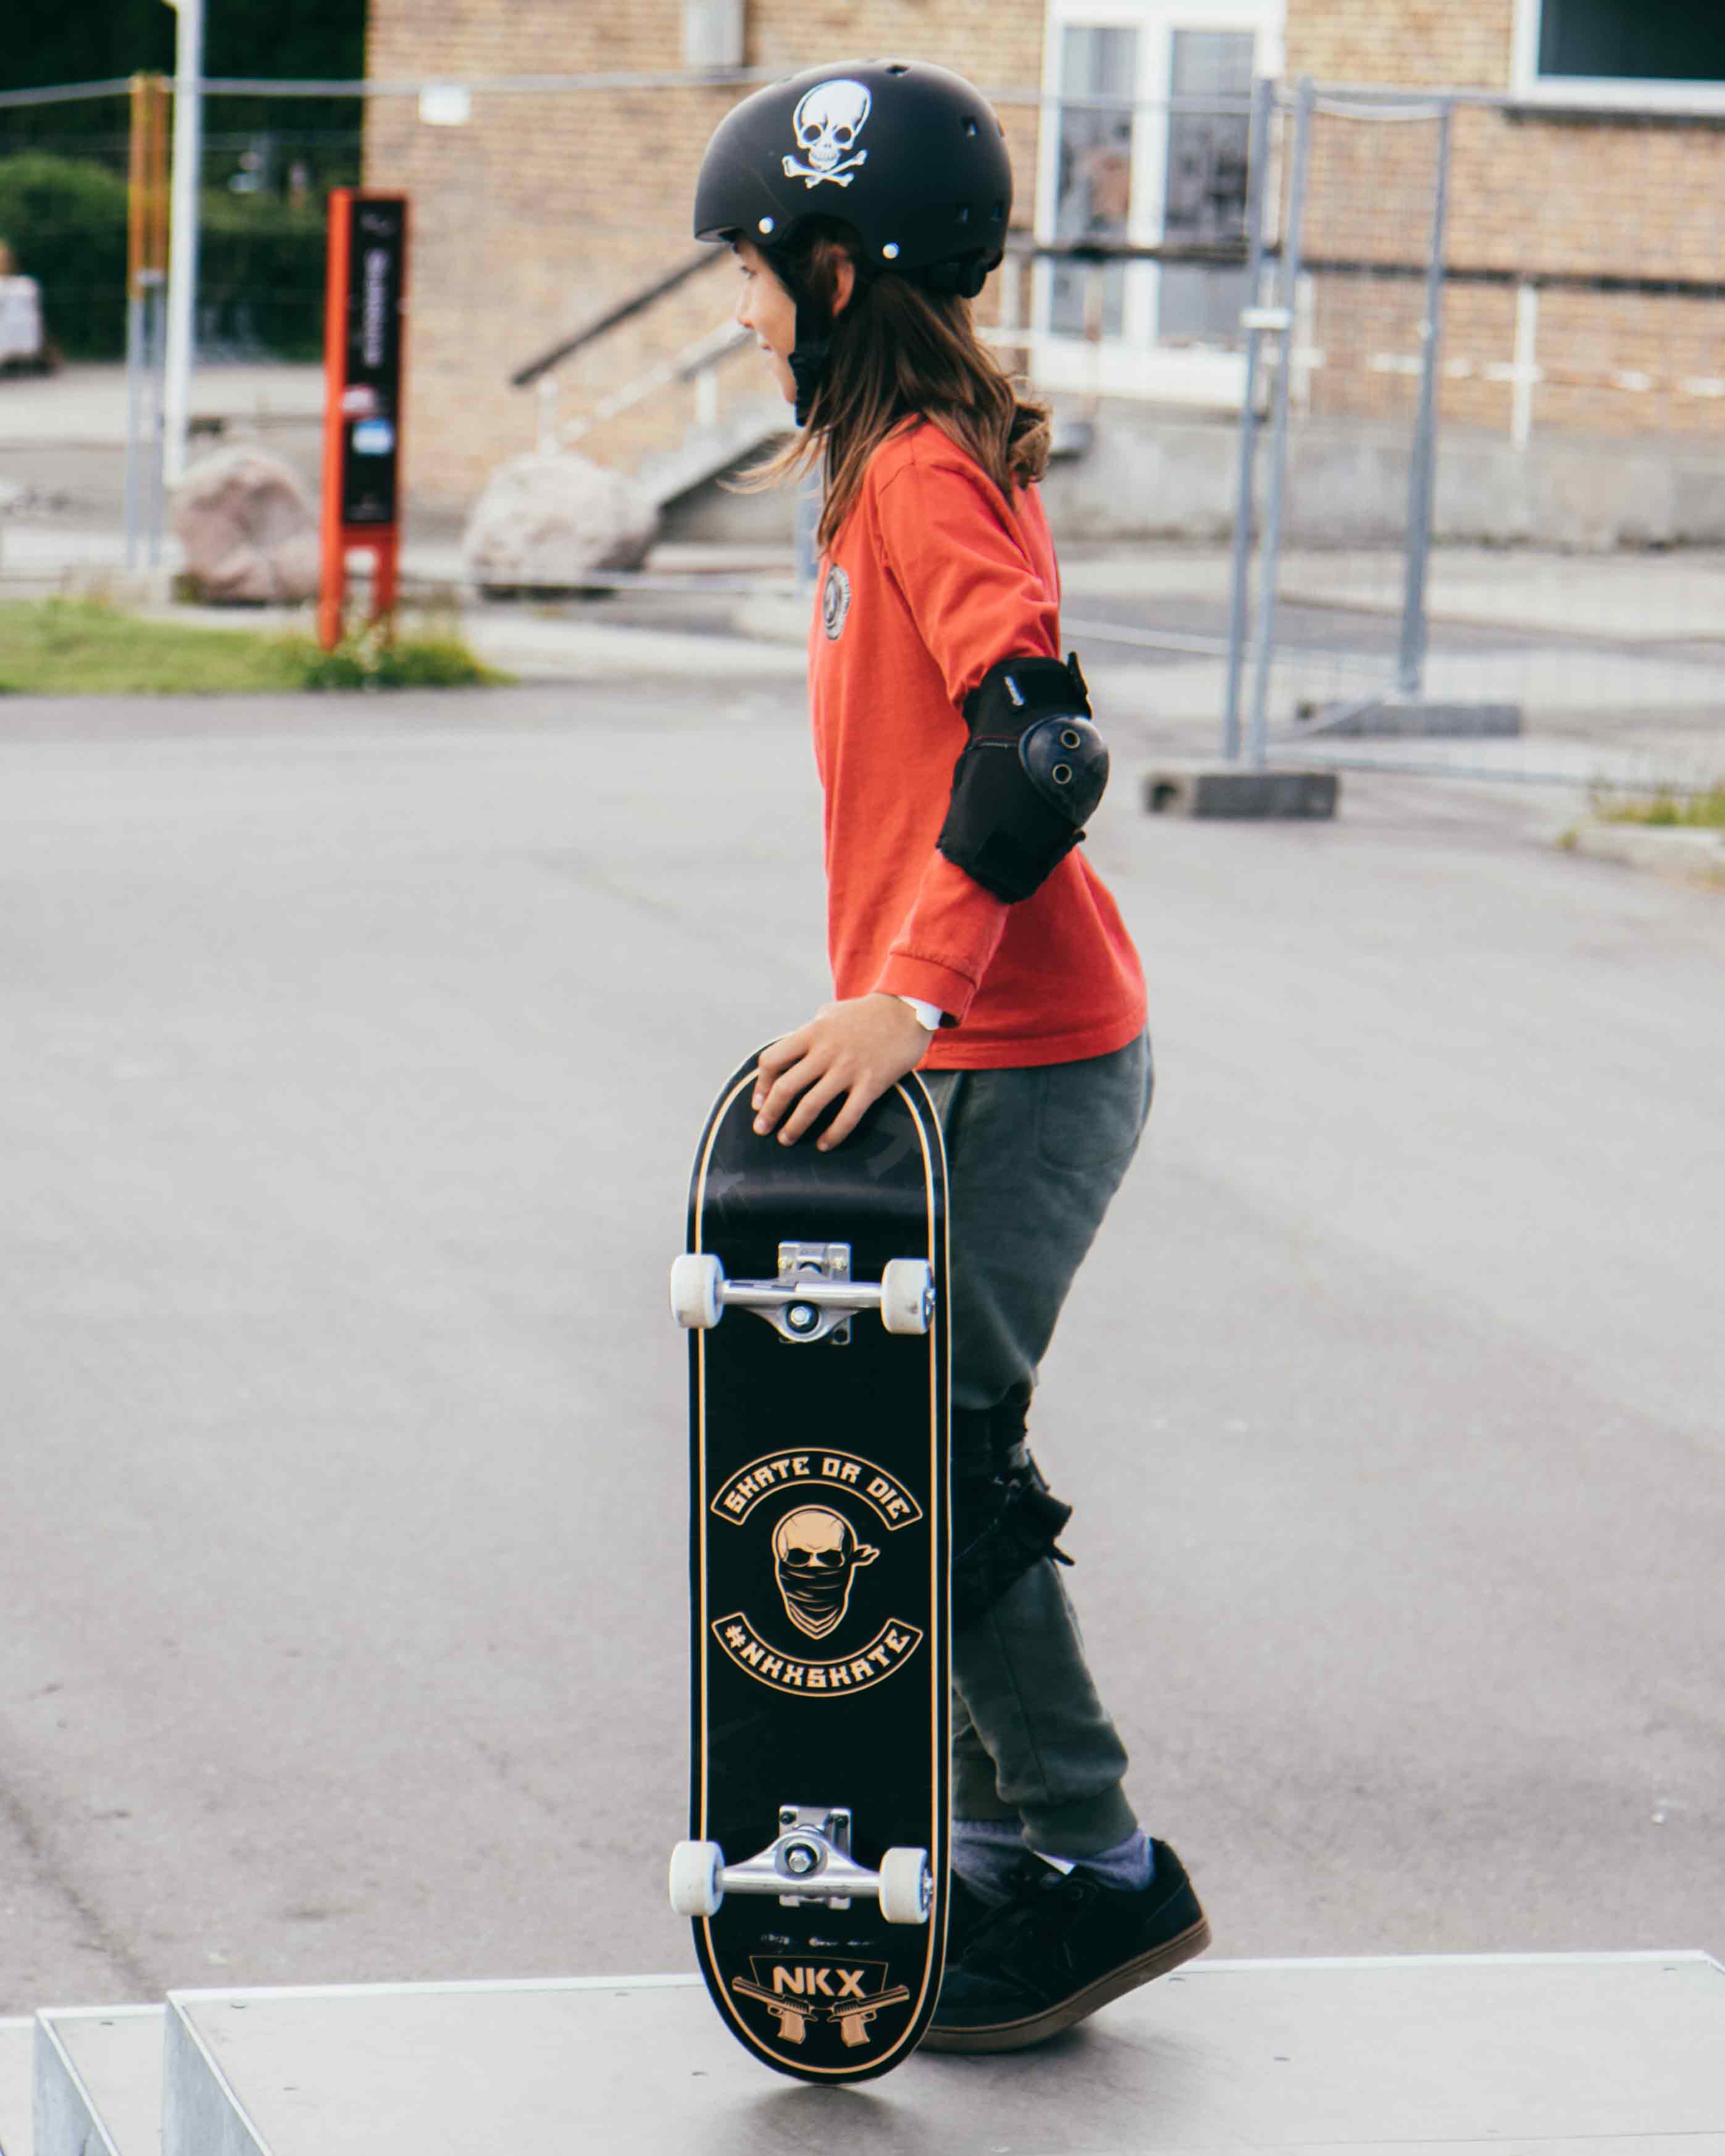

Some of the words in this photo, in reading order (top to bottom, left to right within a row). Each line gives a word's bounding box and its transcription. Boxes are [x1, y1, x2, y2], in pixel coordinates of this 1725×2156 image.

[723, 1456, 811, 1515] SKATE
[821, 1456, 862, 1484] OR
[865, 1476, 911, 1519] DIE
[724, 1624, 911, 1689] #NKXSKATE
[772, 1965, 866, 1998] NKX
